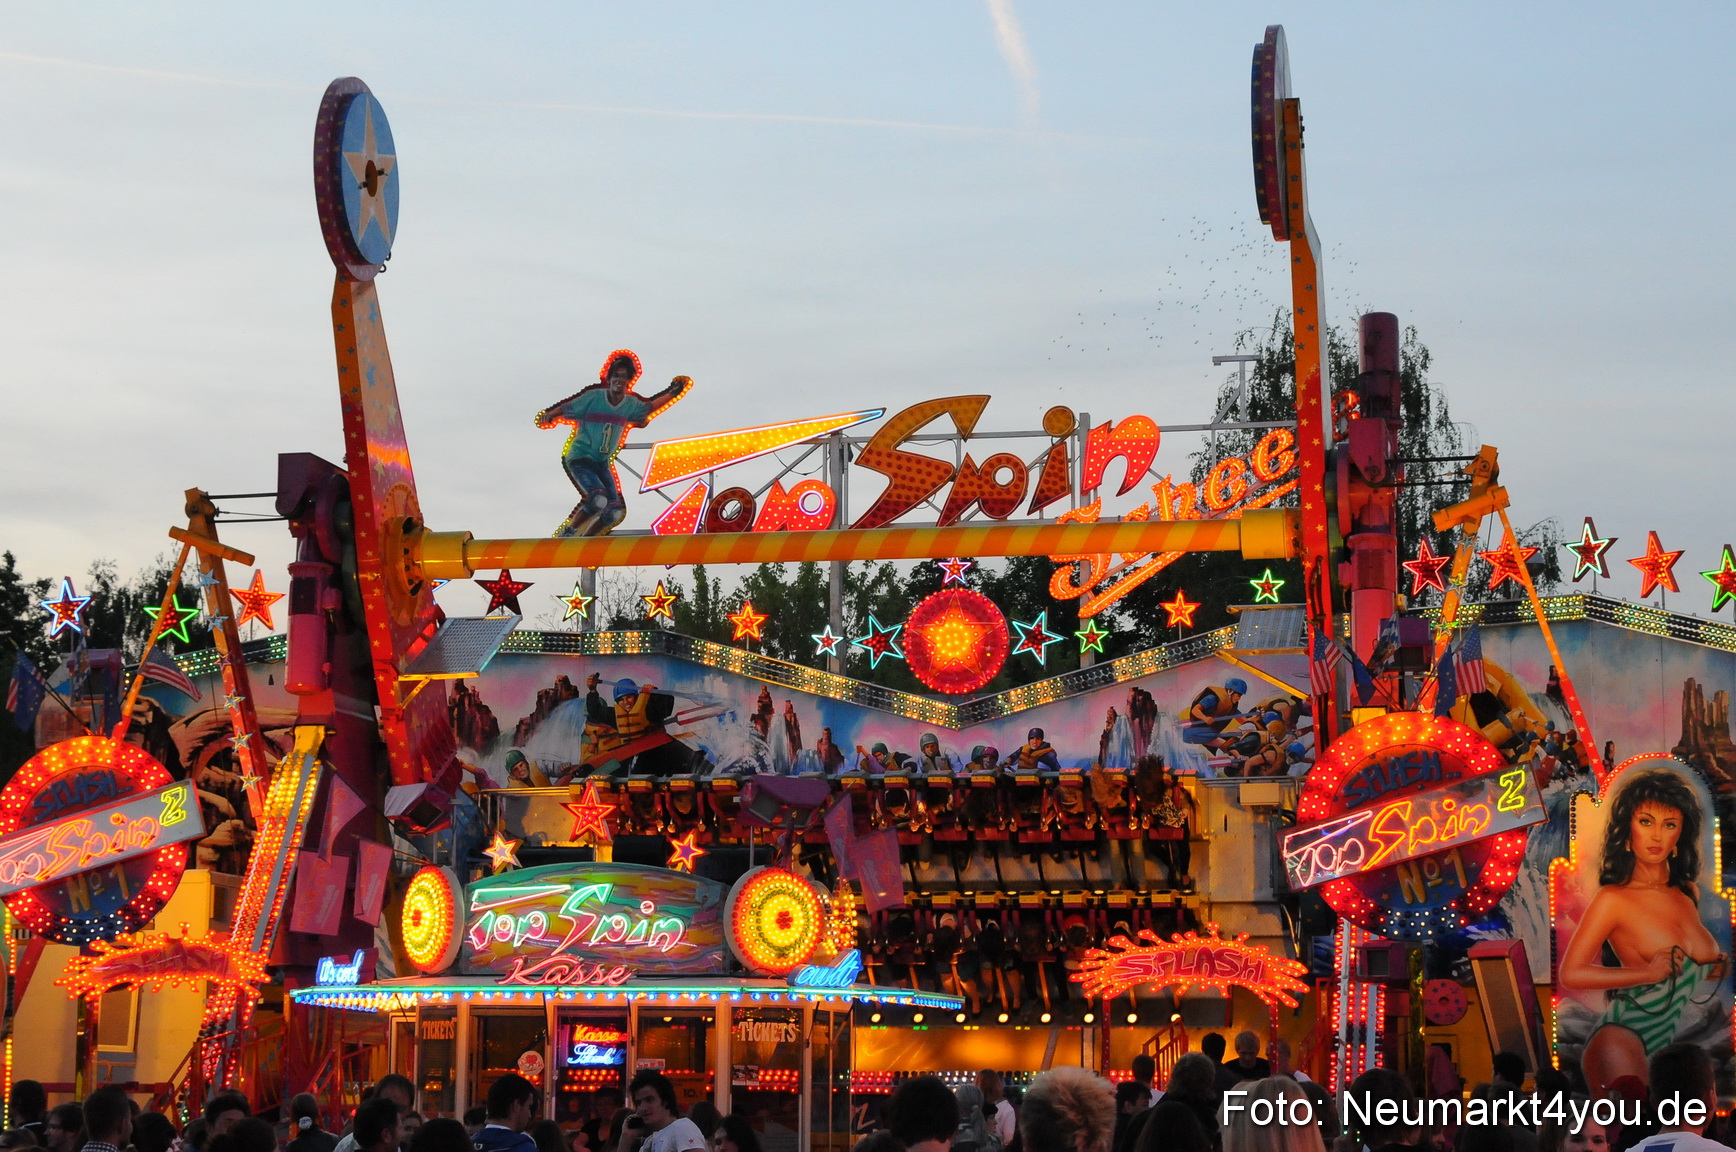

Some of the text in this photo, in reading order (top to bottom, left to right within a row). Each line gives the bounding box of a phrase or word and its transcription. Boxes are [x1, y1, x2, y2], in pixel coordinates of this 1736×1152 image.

[599, 422, 614, 454] 1
[847, 394, 1161, 567] Spin
[36, 812, 160, 881] Spin
[1283, 810, 1374, 887] Top
[1361, 799, 1491, 872] Spin
[469, 883, 688, 956] Top Spin
[495, 953, 637, 986] Kasse
[1109, 946, 1265, 985] SPLASH
[421, 1020, 455, 1040] TICKETS
[573, 1025, 620, 1042] Kasse
[738, 1021, 797, 1043] TICKETS
